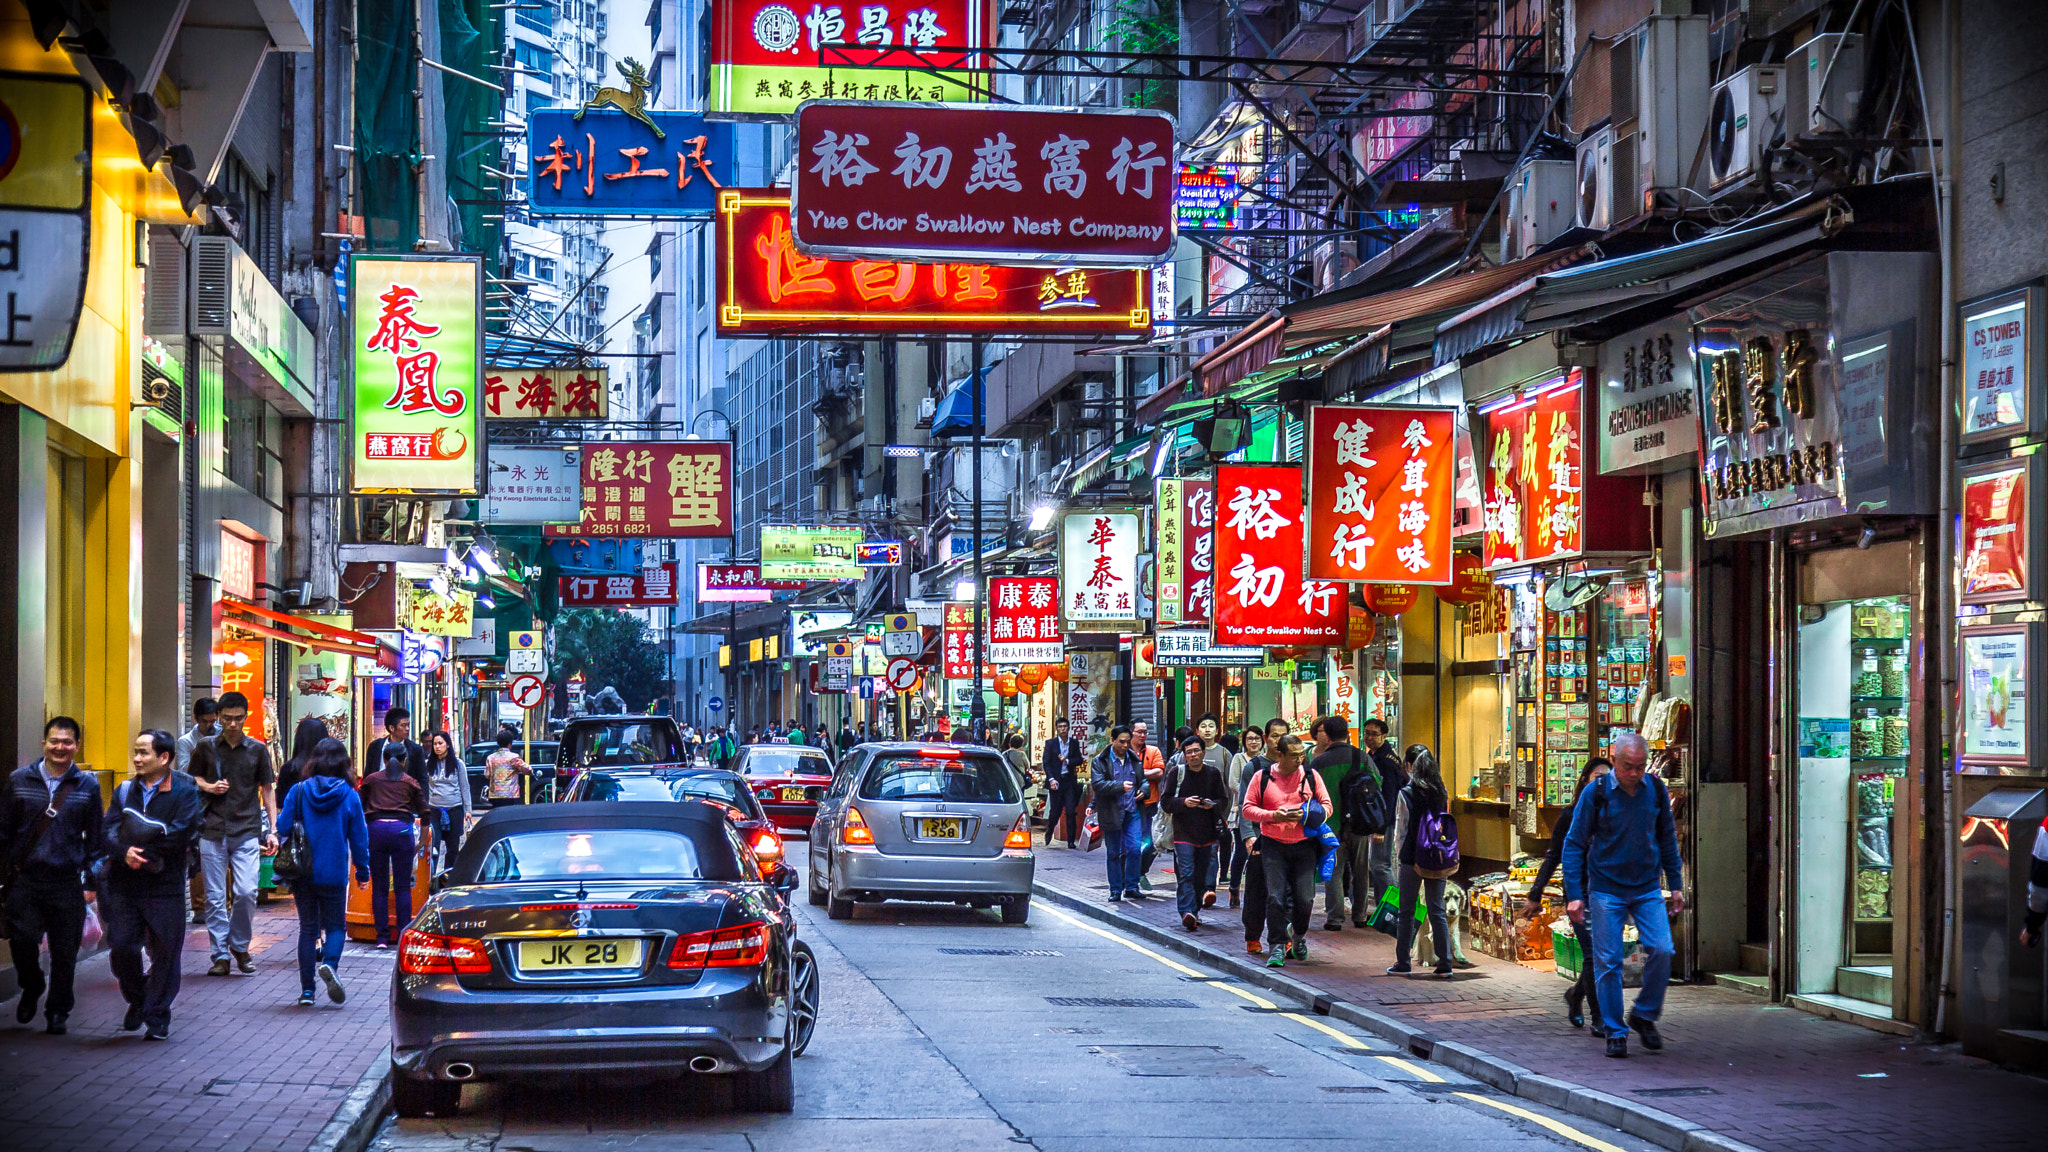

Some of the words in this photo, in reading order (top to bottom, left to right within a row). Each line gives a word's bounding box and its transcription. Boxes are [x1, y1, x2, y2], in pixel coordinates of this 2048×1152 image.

[804, 4, 947, 54] 恒昌隆
[534, 133, 722, 196] 利工民
[808, 129, 1166, 199] 裕初燕窩行
[807, 210, 848, 230] Yue
[856, 210, 907, 230] Chor
[916, 212, 1004, 234] Swallow
[1013, 215, 1061, 236] Nest
[1069, 217, 1164, 242] Company
[1974, 328, 1987, 346] CS
[1988, 320, 2021, 343] TOWER
[368, 435, 433, 458] 燕窩行
[511, 464, 550, 481] 永光
[1330, 418, 1377, 571] 健成行
[1396, 418, 1433, 574] 參茸海味
[592, 524, 619, 534] 2851
[624, 524, 651, 534] 6821
[1086, 516, 1123, 590] 華泰
[1225, 486, 1291, 608] 裕初
[998, 582, 1053, 610] 康泰
[1073, 591, 1131, 610] 燕窩莊
[994, 615, 1059, 639] 燕窩莊
[1226, 625, 1243, 634] Yue
[1245, 625, 1265, 635] Chor
[1266, 625, 1301, 635] Swallow
[1303, 626, 1322, 635] Nest
[1325, 626, 1339, 635] Co.
[1159, 636, 1206, 652] 蘇瑞龍
[1159, 656, 1179, 664] Eric
[1257, 670, 1272, 678] No.
[926, 827, 955, 838] 1558
[930, 818, 949, 828] SK
[541, 945, 573, 965] JK
[585, 944, 618, 964] 28
